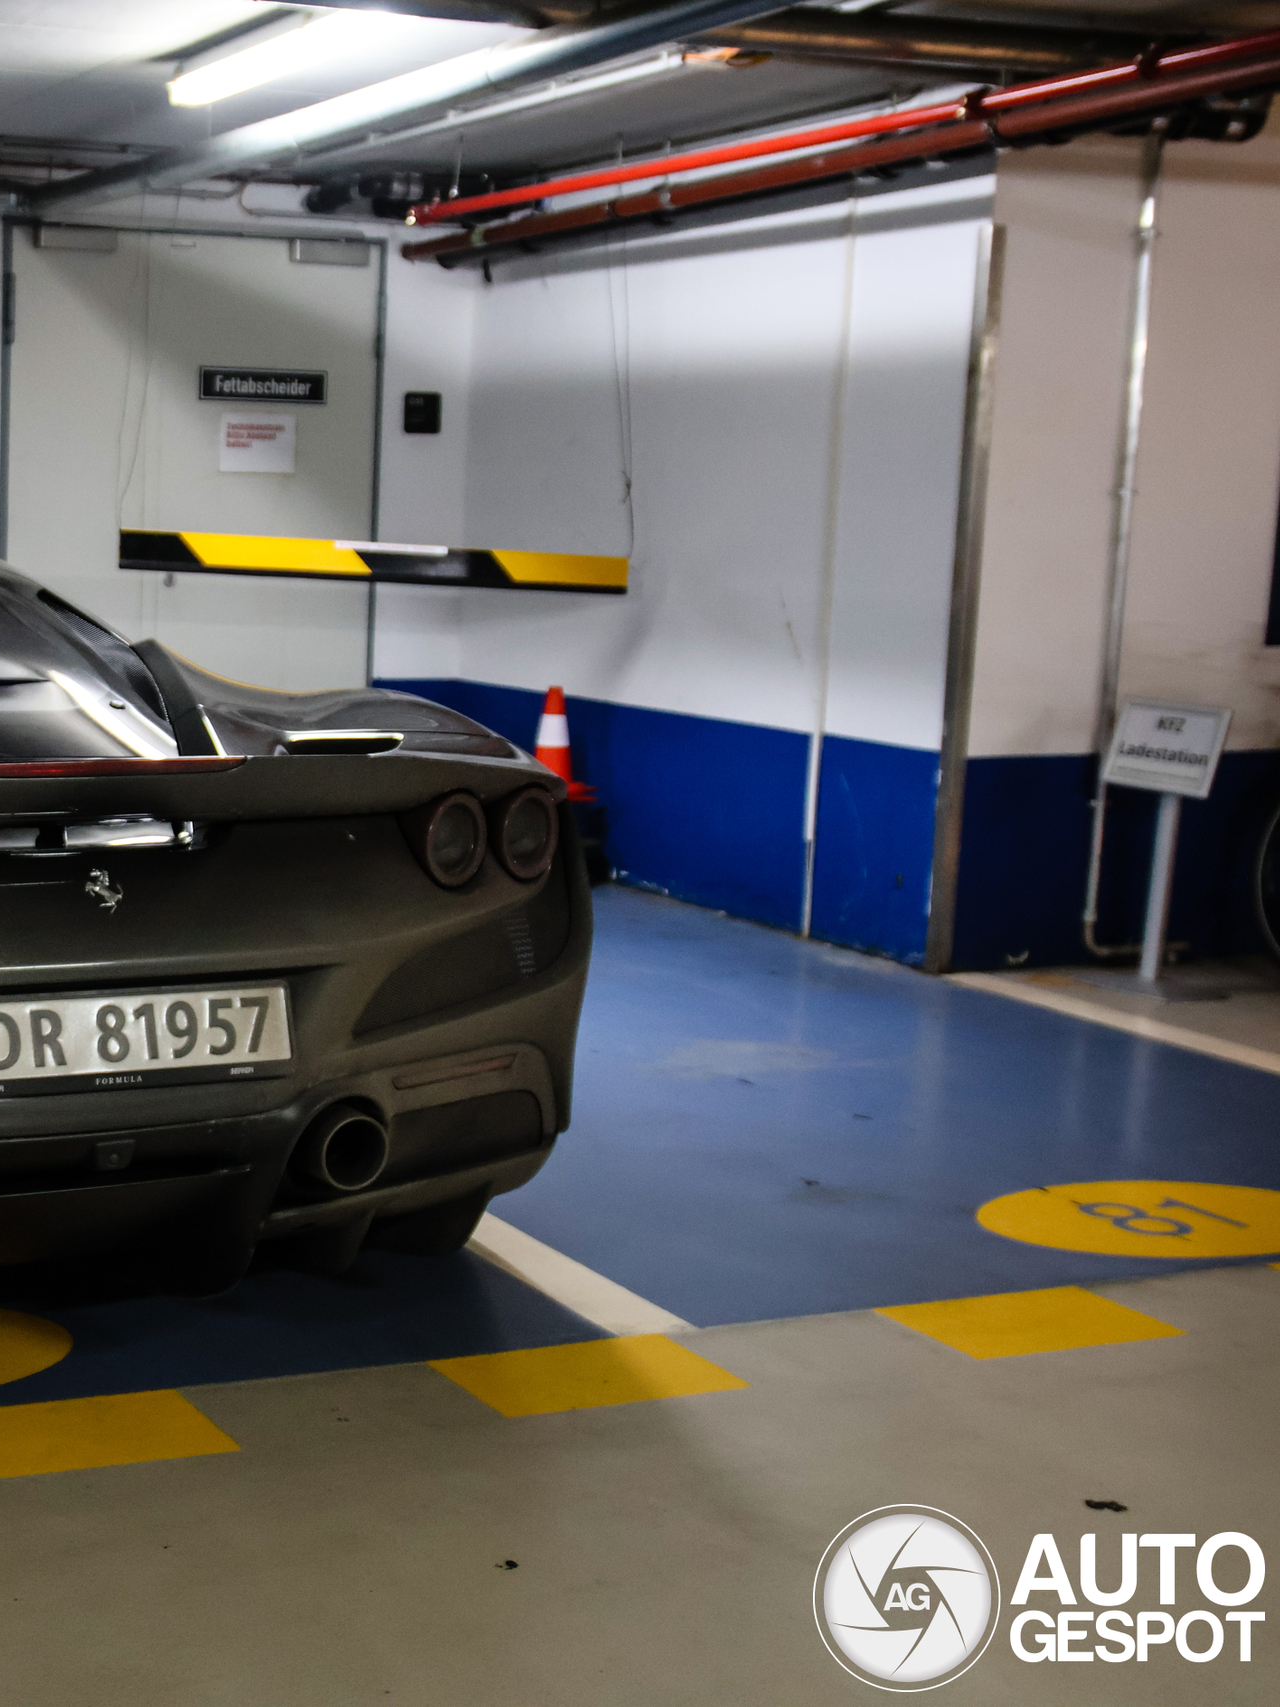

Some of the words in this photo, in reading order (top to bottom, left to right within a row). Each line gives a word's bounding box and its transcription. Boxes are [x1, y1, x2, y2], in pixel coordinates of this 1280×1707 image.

[214, 375, 312, 396] Fettabscheider
[1119, 741, 1209, 767] Ladestation
[96, 996, 270, 1063] 81957
[95, 1075, 143, 1086] FORMULA
[1078, 1197, 1249, 1237] 81
